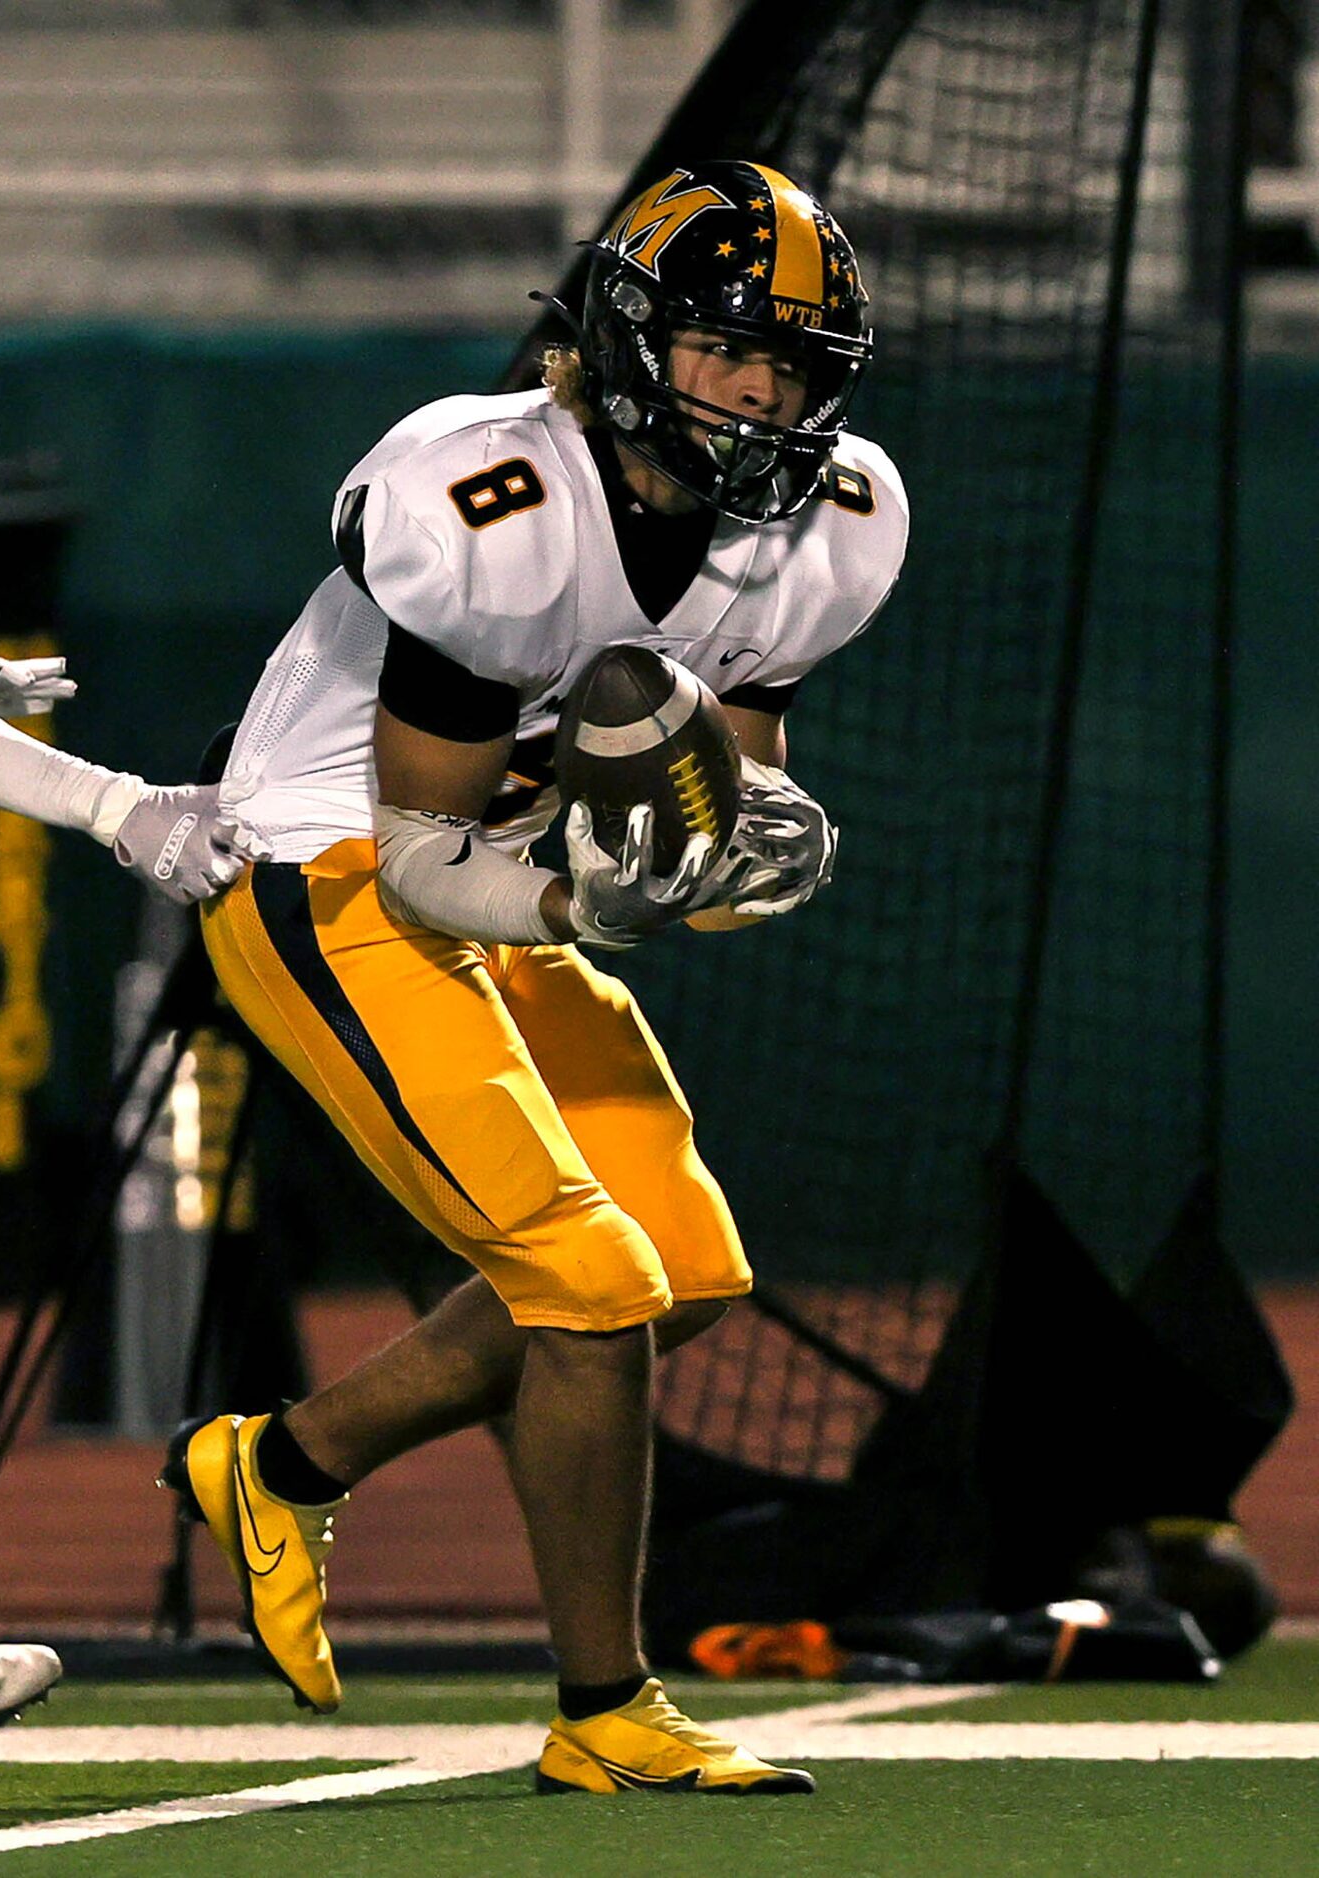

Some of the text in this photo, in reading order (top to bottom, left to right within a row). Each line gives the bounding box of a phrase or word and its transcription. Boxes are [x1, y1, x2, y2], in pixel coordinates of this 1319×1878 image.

[598, 168, 737, 282] M
[773, 301, 823, 329] WTB
[446, 456, 549, 532] 8
